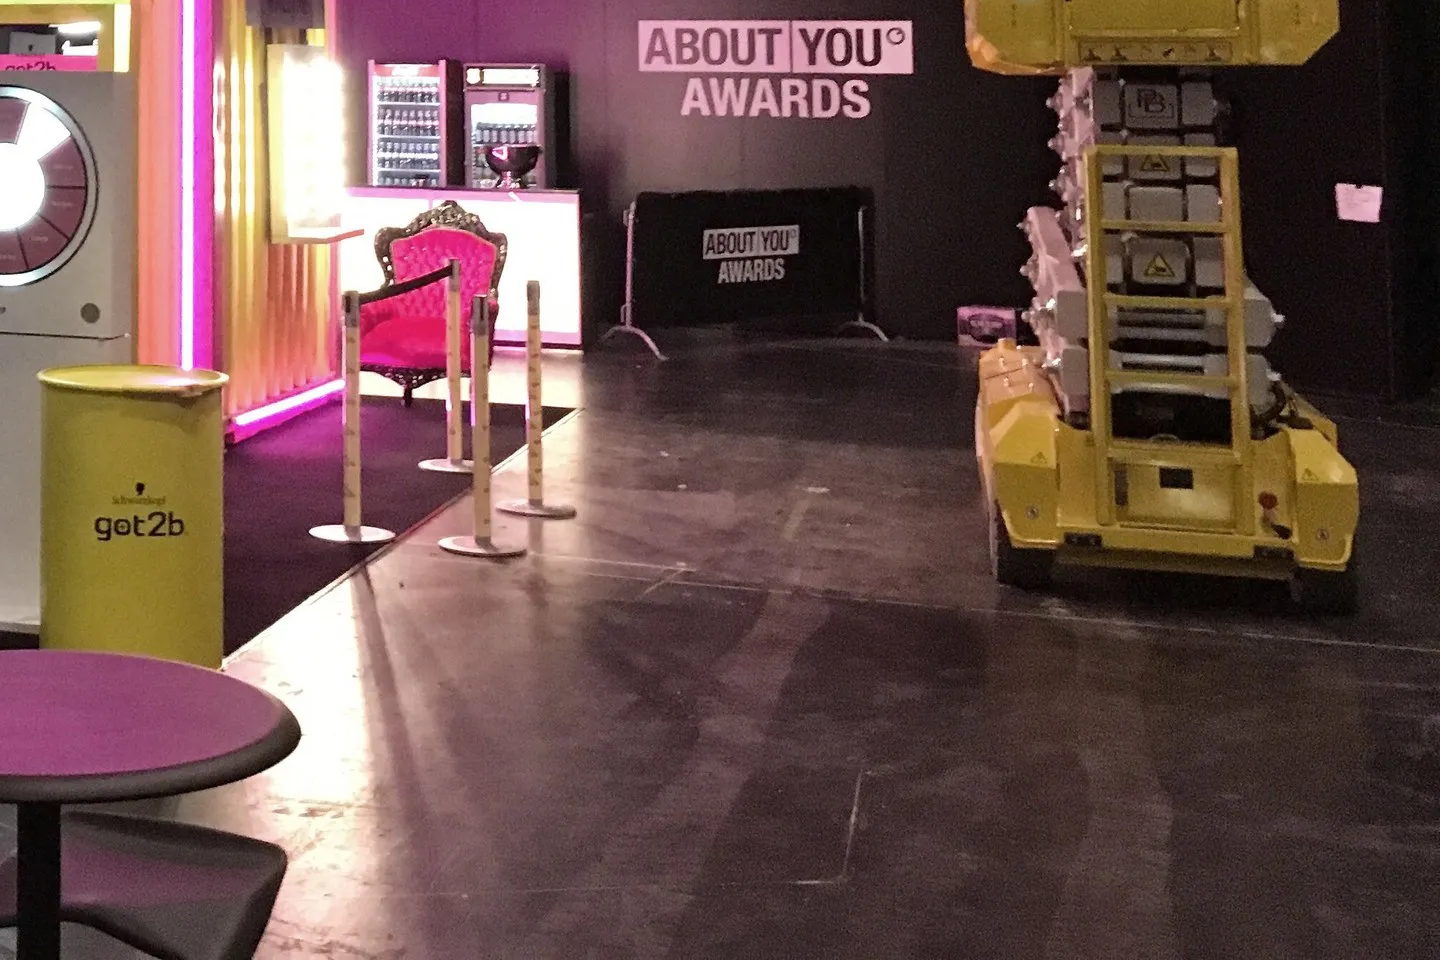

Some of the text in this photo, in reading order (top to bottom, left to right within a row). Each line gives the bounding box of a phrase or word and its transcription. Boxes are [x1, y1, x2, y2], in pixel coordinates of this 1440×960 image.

[644, 27, 782, 66] ABOUT
[680, 77, 872, 119] AWARDS
[705, 231, 756, 256] ABOUT
[717, 257, 786, 284] AWARDS
[94, 510, 185, 542] got2b
